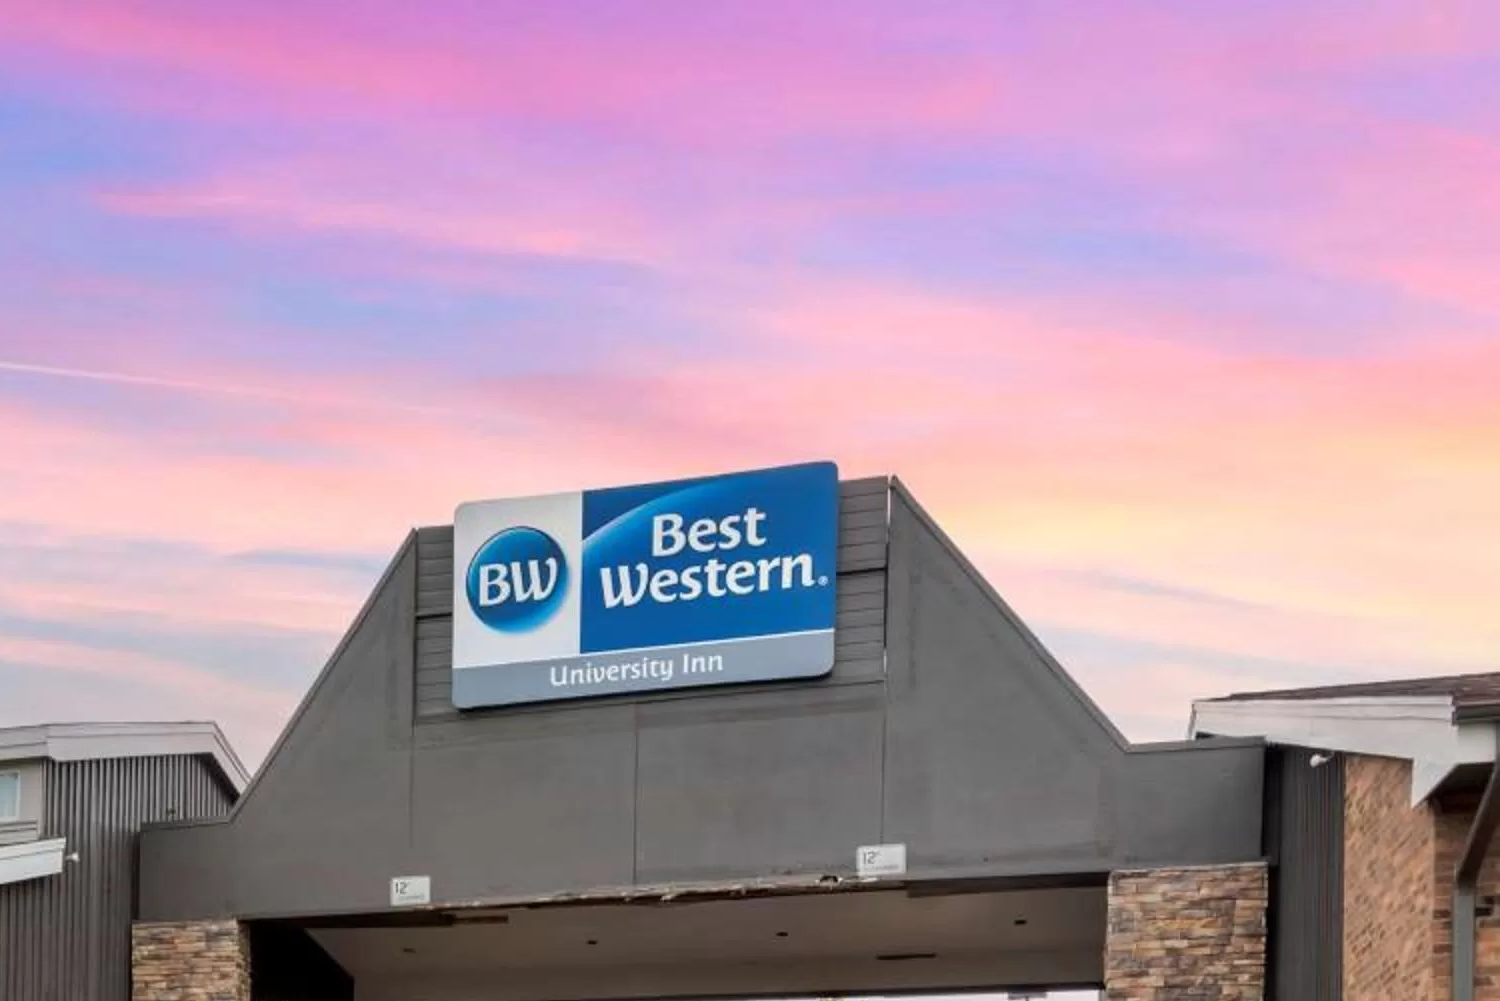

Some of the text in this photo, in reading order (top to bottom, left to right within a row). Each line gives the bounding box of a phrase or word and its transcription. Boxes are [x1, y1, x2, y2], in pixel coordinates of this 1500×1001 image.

[652, 507, 767, 558] Best
[478, 557, 558, 607] BW
[600, 552, 816, 609] Western
[550, 651, 724, 688] University Inn
